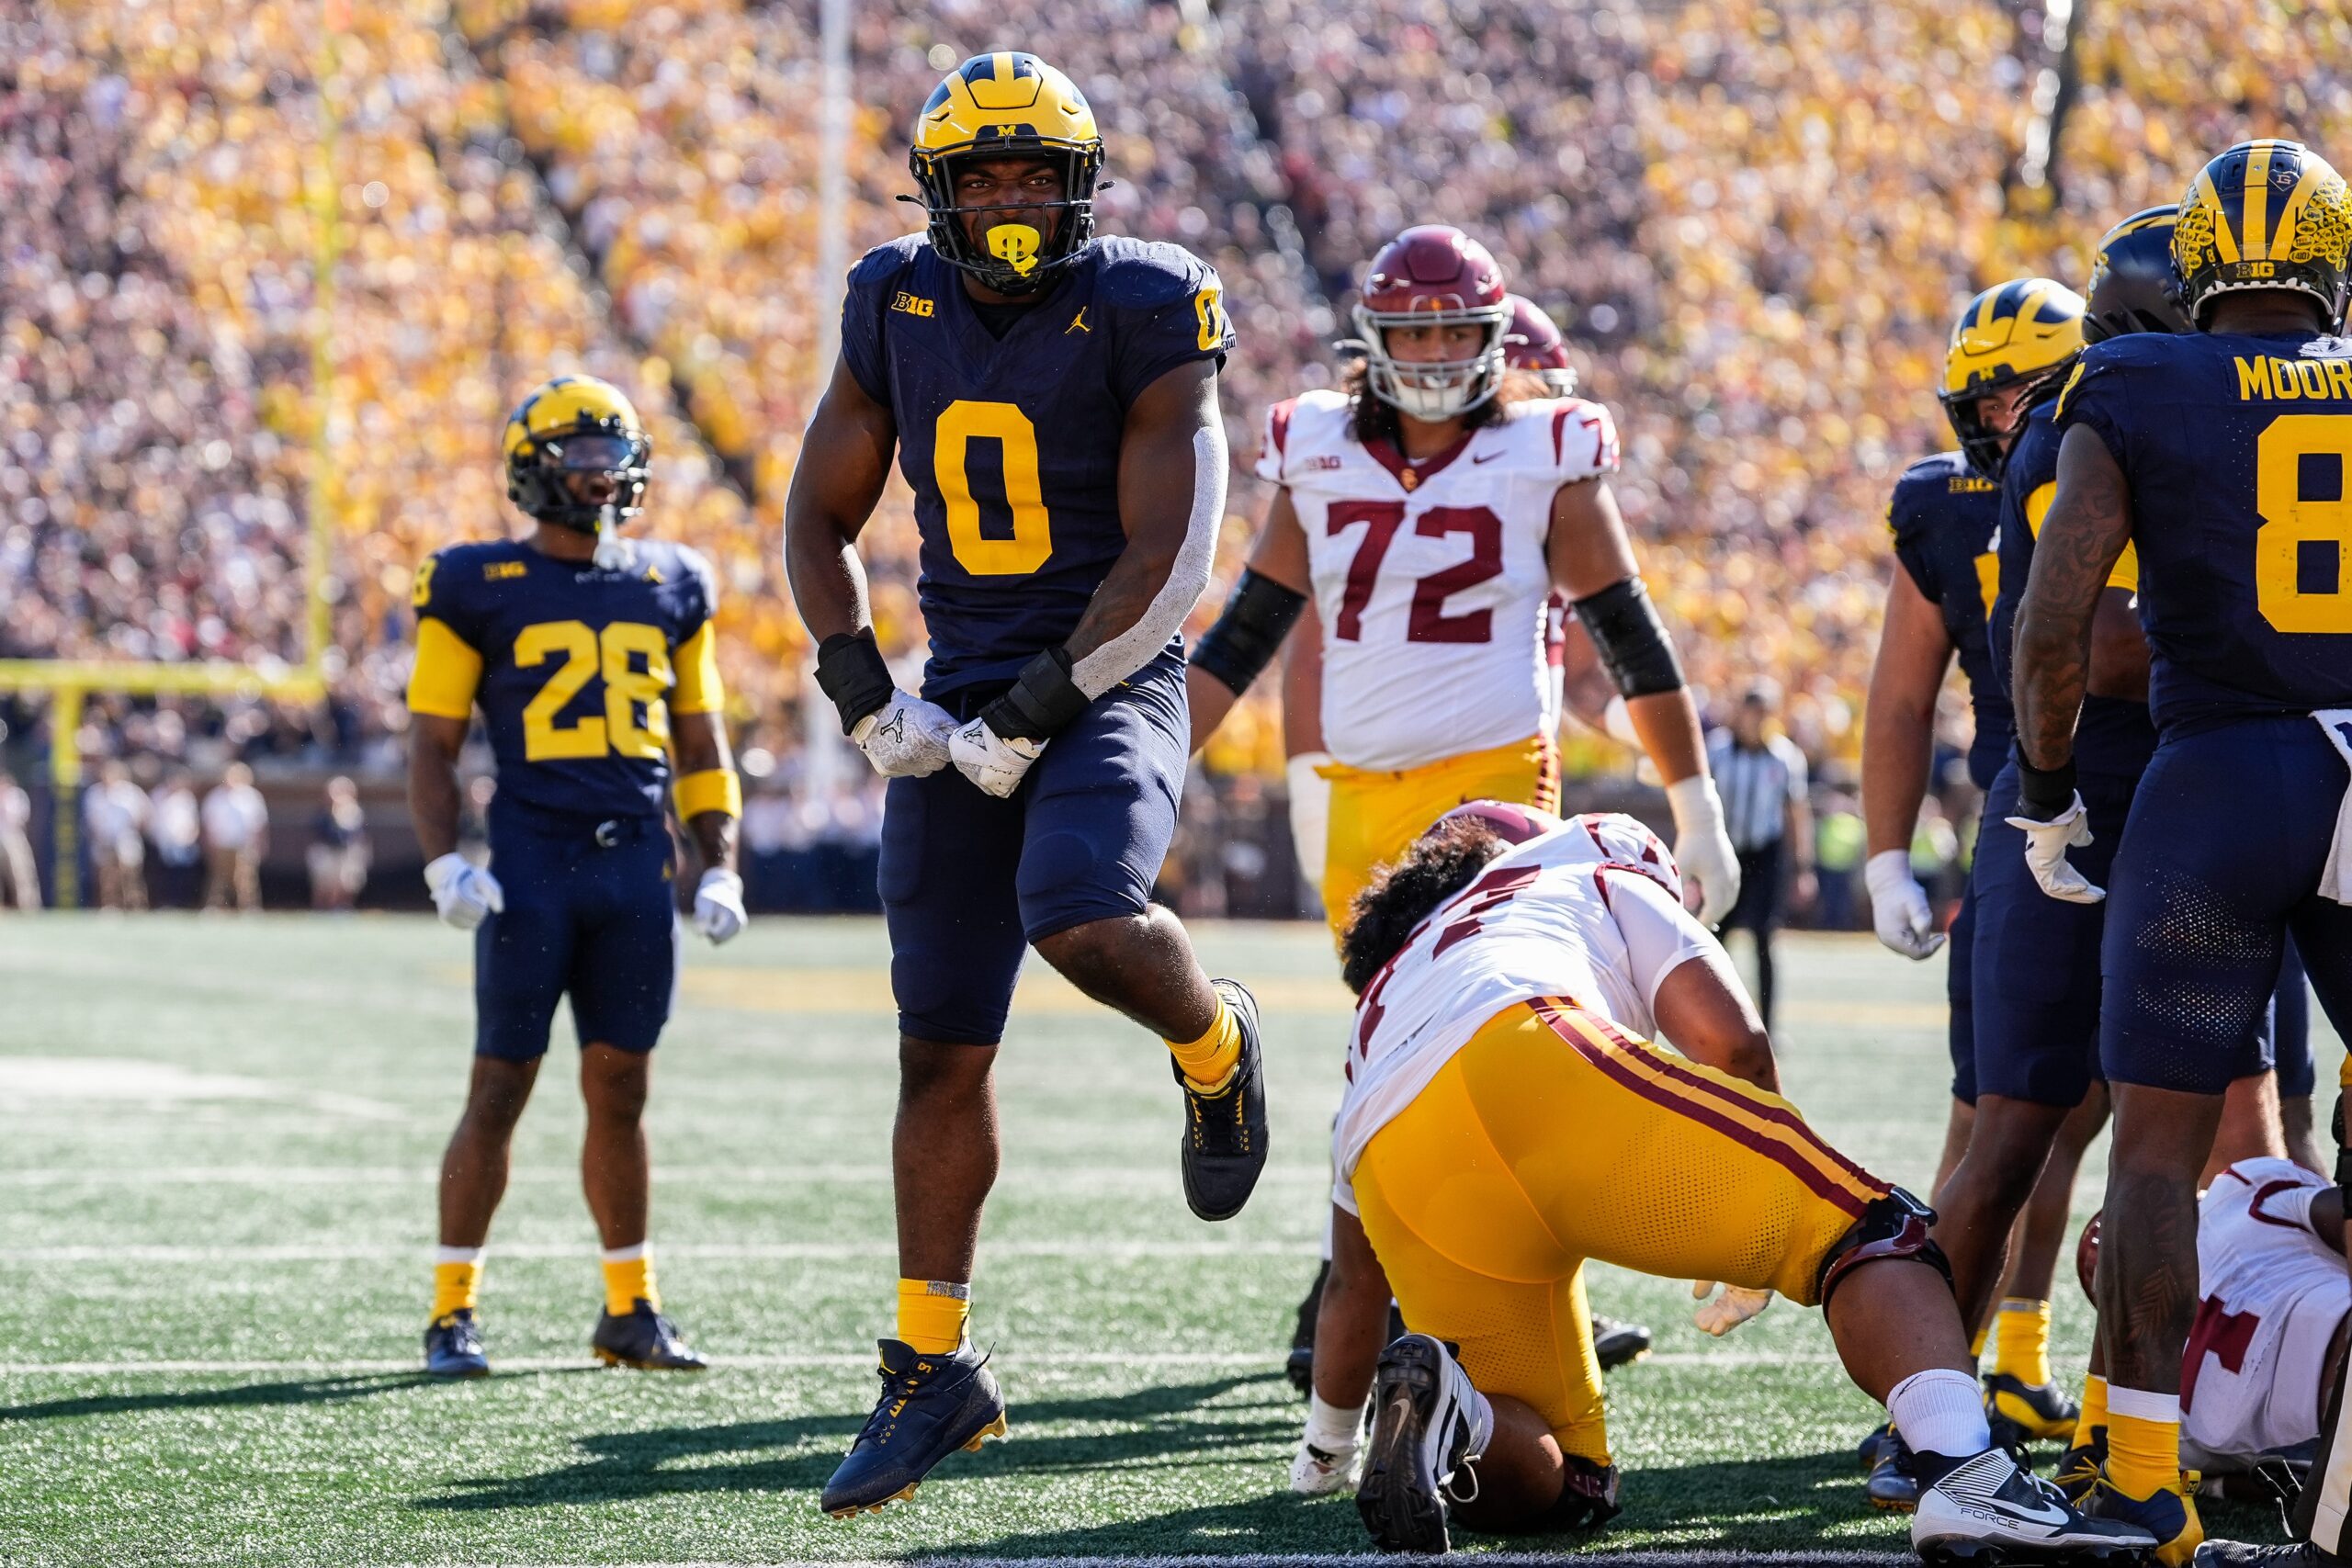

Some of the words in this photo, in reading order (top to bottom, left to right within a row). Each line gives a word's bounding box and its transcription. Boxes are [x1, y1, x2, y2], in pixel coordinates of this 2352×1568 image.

[997, 125, 1017, 137] M
[2236, 262, 2275, 278] BIG
[891, 291, 935, 318] BIG
[1195, 286, 1222, 351] 0
[933, 399, 1054, 576] 0
[2256, 414, 2352, 634] 8
[1327, 500, 1504, 644] 72
[513, 619, 672, 763] 28
[1961, 1507, 2020, 1530] FORCE
